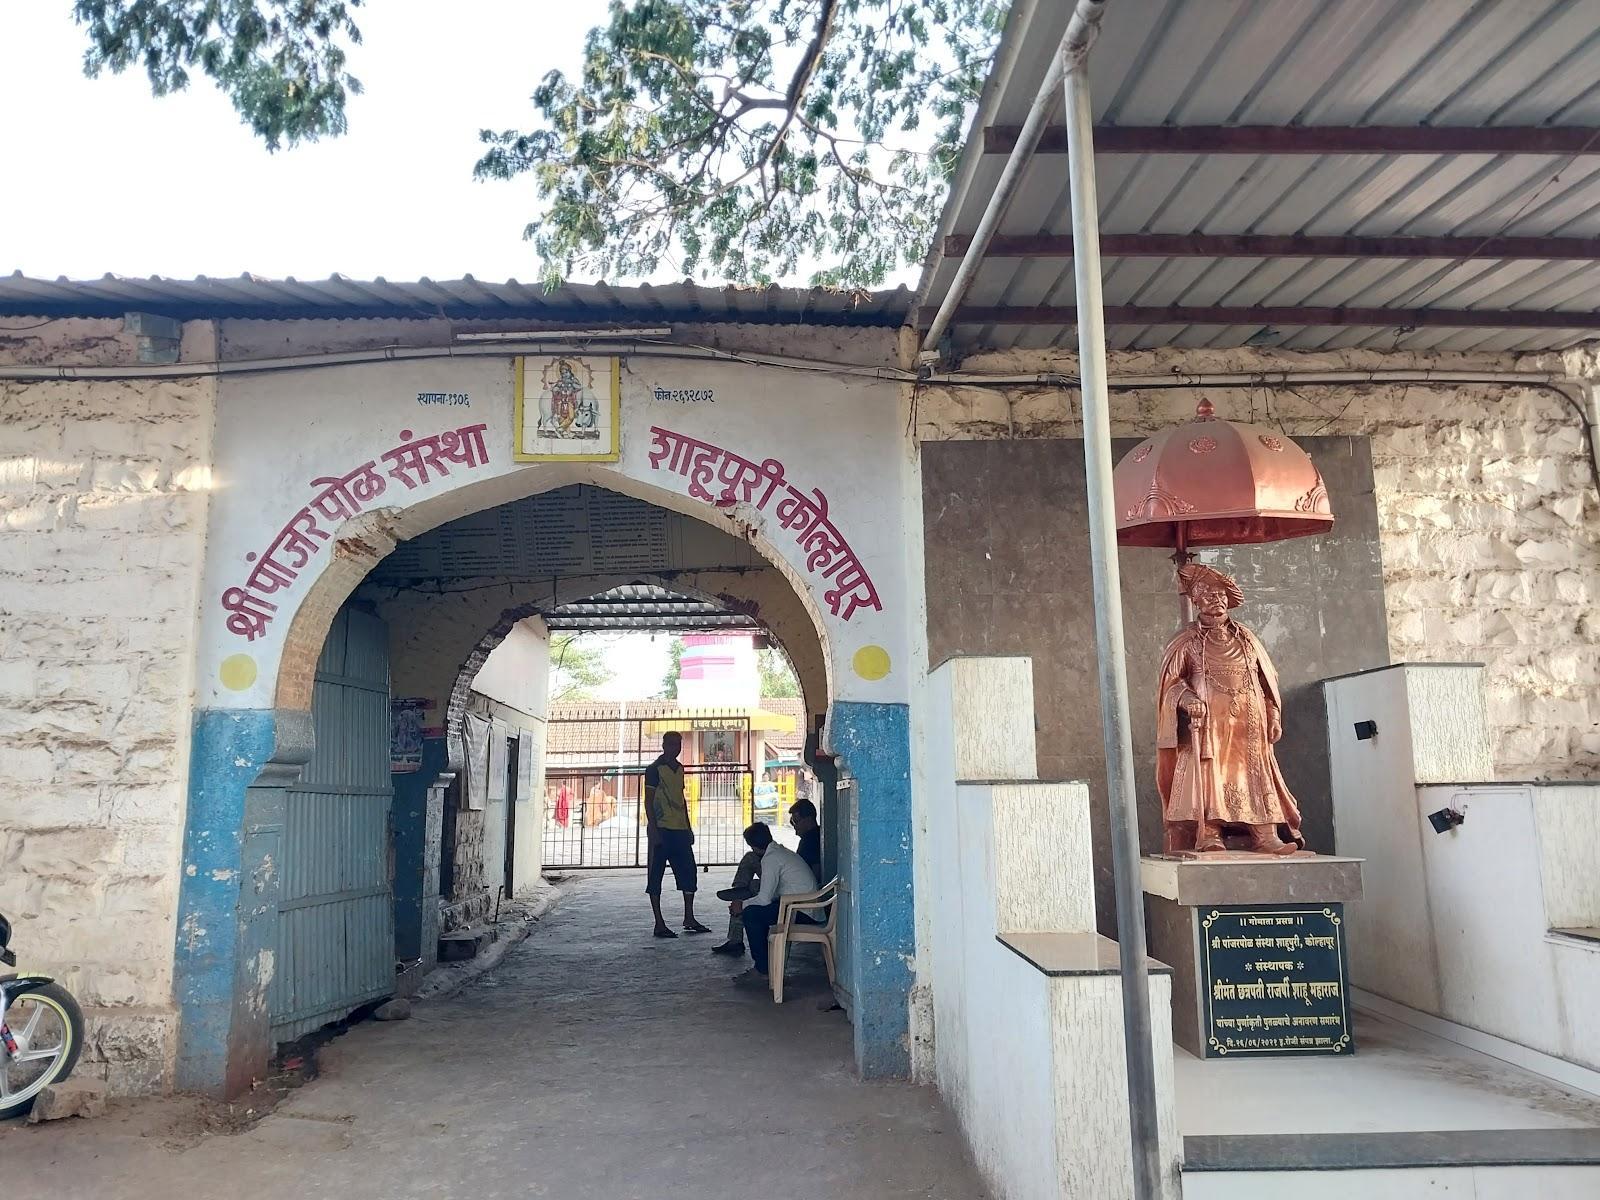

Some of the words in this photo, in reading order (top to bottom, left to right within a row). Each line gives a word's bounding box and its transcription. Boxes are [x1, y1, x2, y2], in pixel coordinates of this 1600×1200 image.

[380, 423, 490, 490] संस्था
[776, 485, 883, 622] कोल्हापूर
[1248, 916, 1274, 926] गोमाता
[1211, 936, 1221, 949] श्री
[1222, 935, 1254, 949] पांजरपोळ
[1255, 935, 1274, 948] संस्था
[1304, 933, 1335, 950] कोल्हापूर
[1255, 958, 1294, 971] संस्थापक
[1213, 978, 1235, 1000] श्रीमंत
[1236, 978, 1265, 1000] छत्रपती
[1266, 976, 1291, 999] राजर्षी
[1291, 982, 1313, 1006] शाहू
[1309, 982, 1339, 999] महाराज
[1216, 1016, 1235, 1028] यांच्या
[1292, 1016, 1318, 1027] अनावरण
[1319, 1013, 1341, 1026] समारंभ
